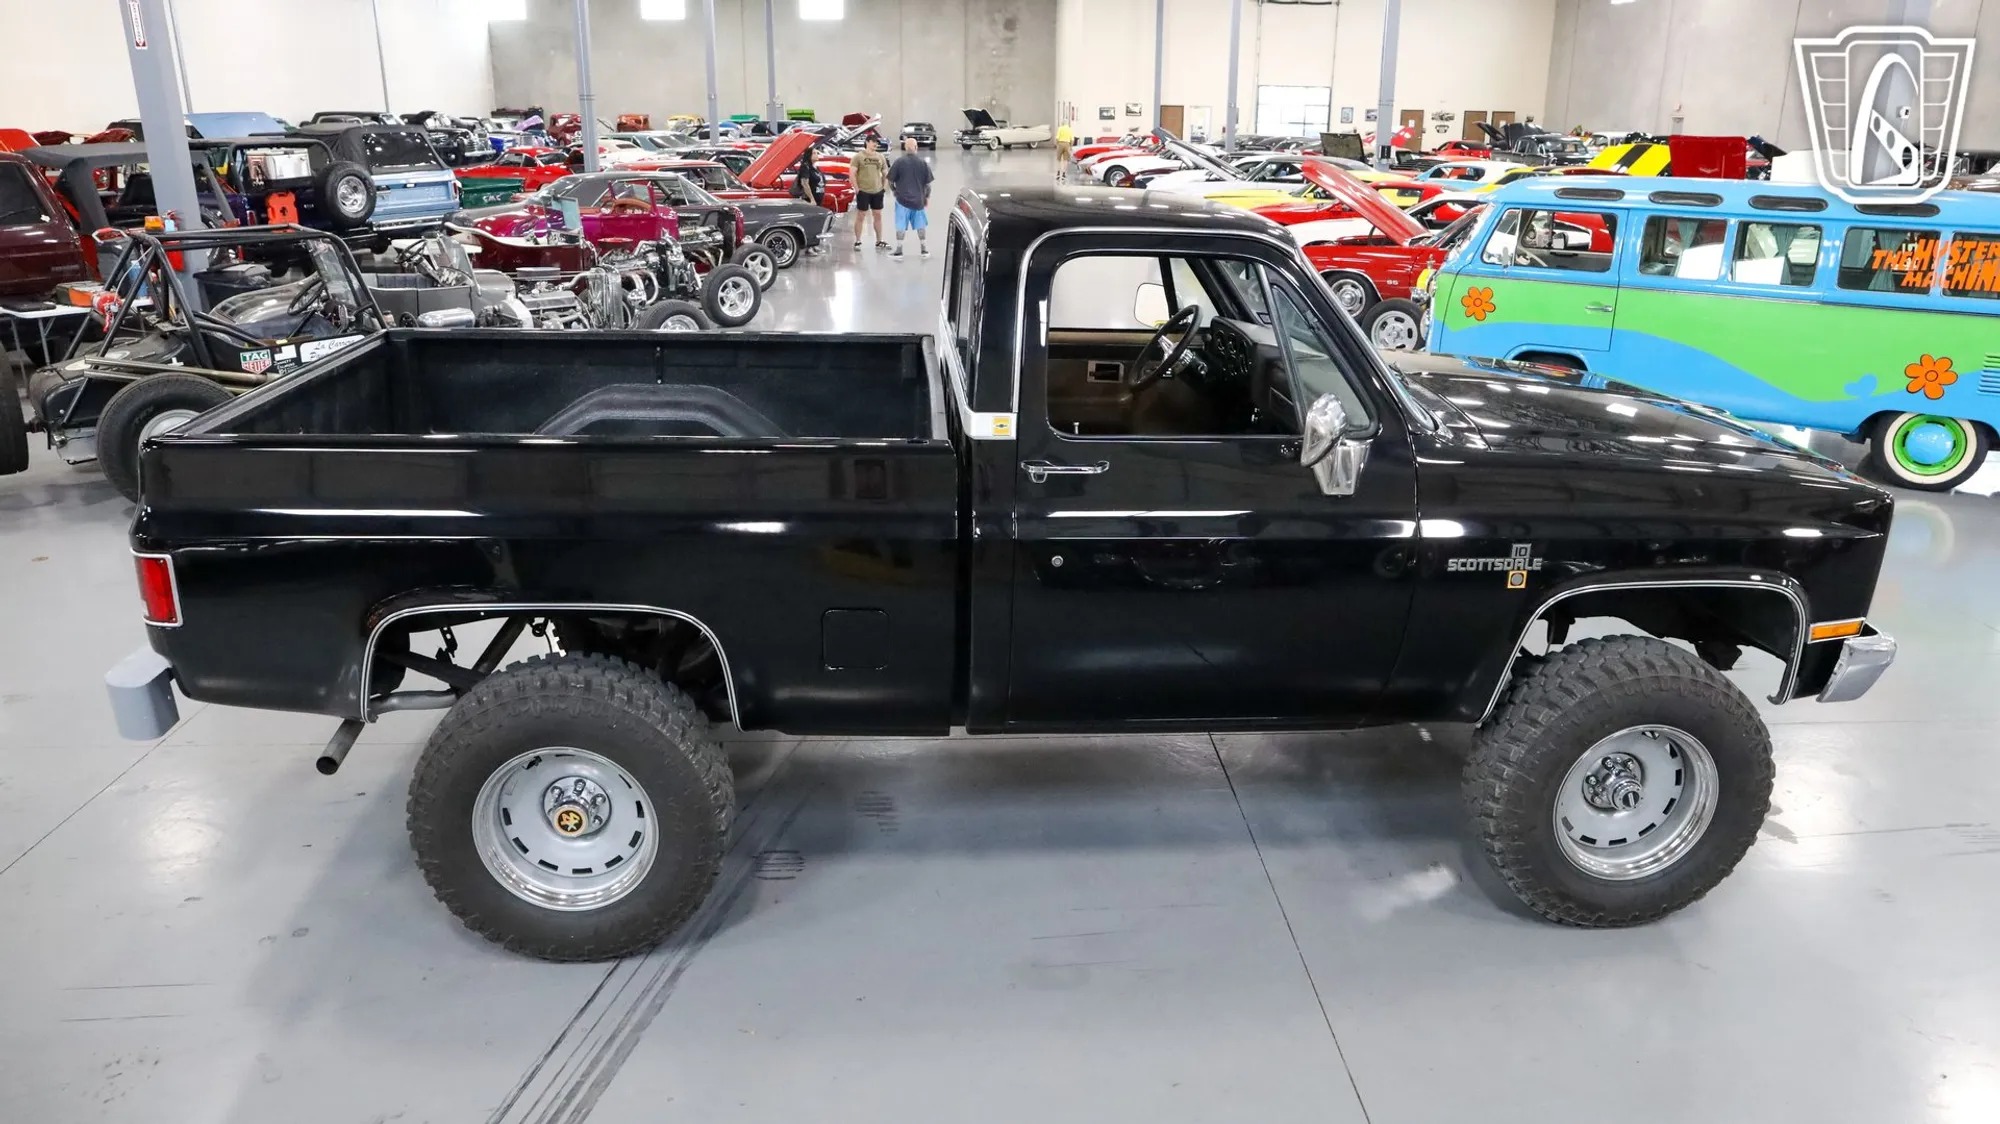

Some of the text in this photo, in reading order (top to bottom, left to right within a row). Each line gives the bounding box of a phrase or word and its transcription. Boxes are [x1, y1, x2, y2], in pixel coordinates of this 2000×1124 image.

[1872, 249, 1912, 271] THE
[1911, 238, 2000, 271] MYSTER
[243, 351, 268, 362] TAG
[242, 360, 271, 372] HEUER
[1513, 546, 1529, 557] 10
[1446, 557, 1543, 572] SCOTTSDALE
